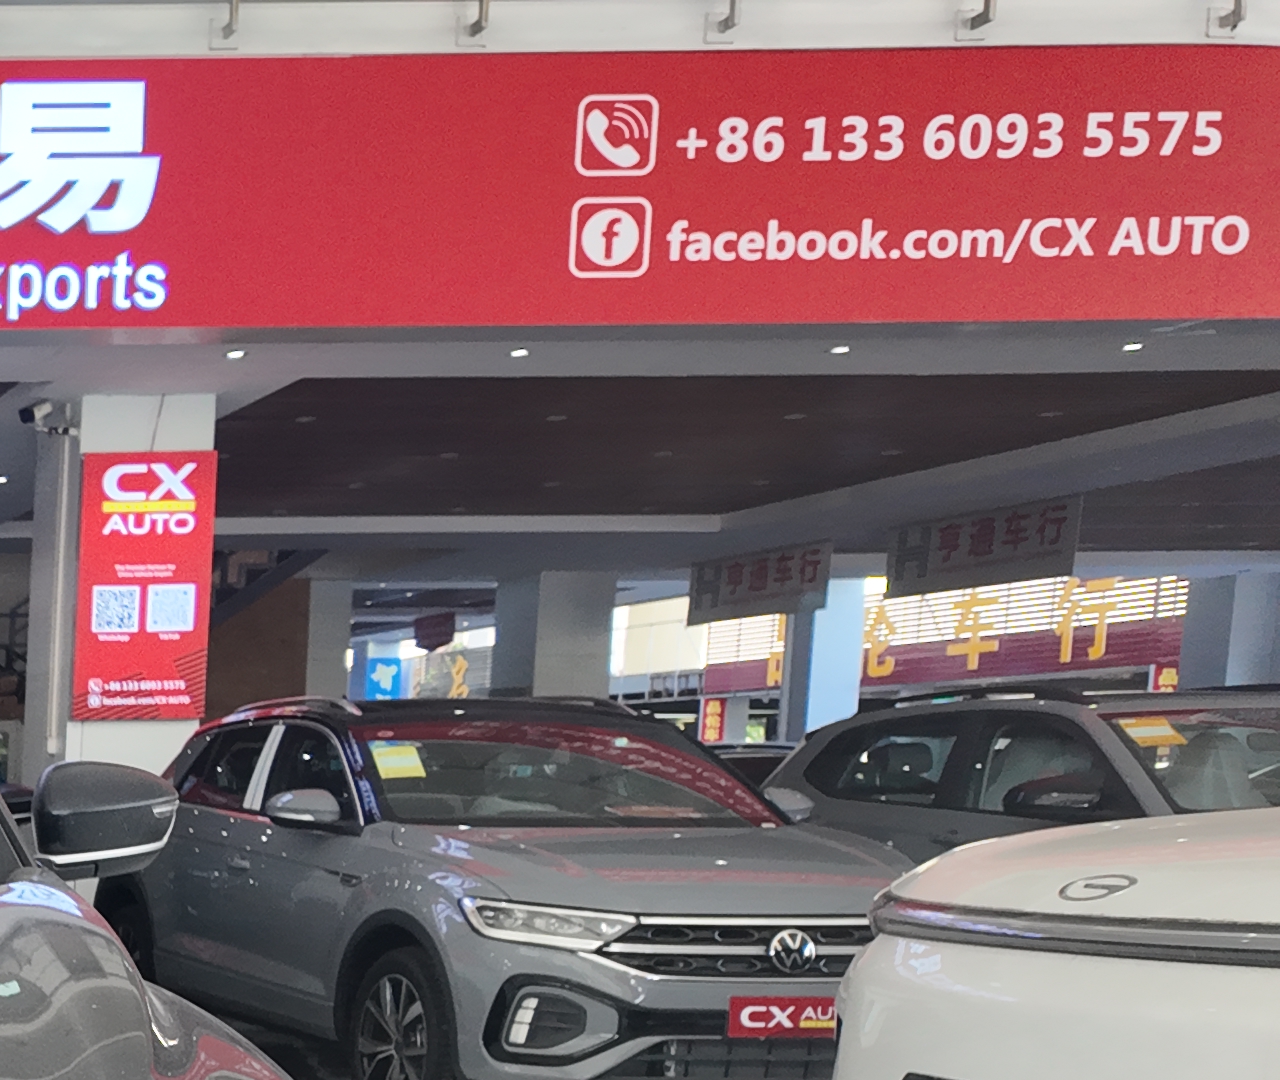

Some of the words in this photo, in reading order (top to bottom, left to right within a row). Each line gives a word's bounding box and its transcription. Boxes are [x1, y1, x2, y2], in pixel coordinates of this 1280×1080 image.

[675, 116, 784, 163] +86
[802, 115, 905, 162] 133
[923, 113, 1064, 160] 6093
[1082, 110, 1223, 157] 5575
[666, 217, 1098, 264] facebook.com/CX
[1107, 215, 1250, 256] AUTO
[101, 462, 198, 501] CX
[102, 513, 196, 535] AUTO
[740, 1006, 795, 1028] CX
[801, 1006, 835, 1020] AU
